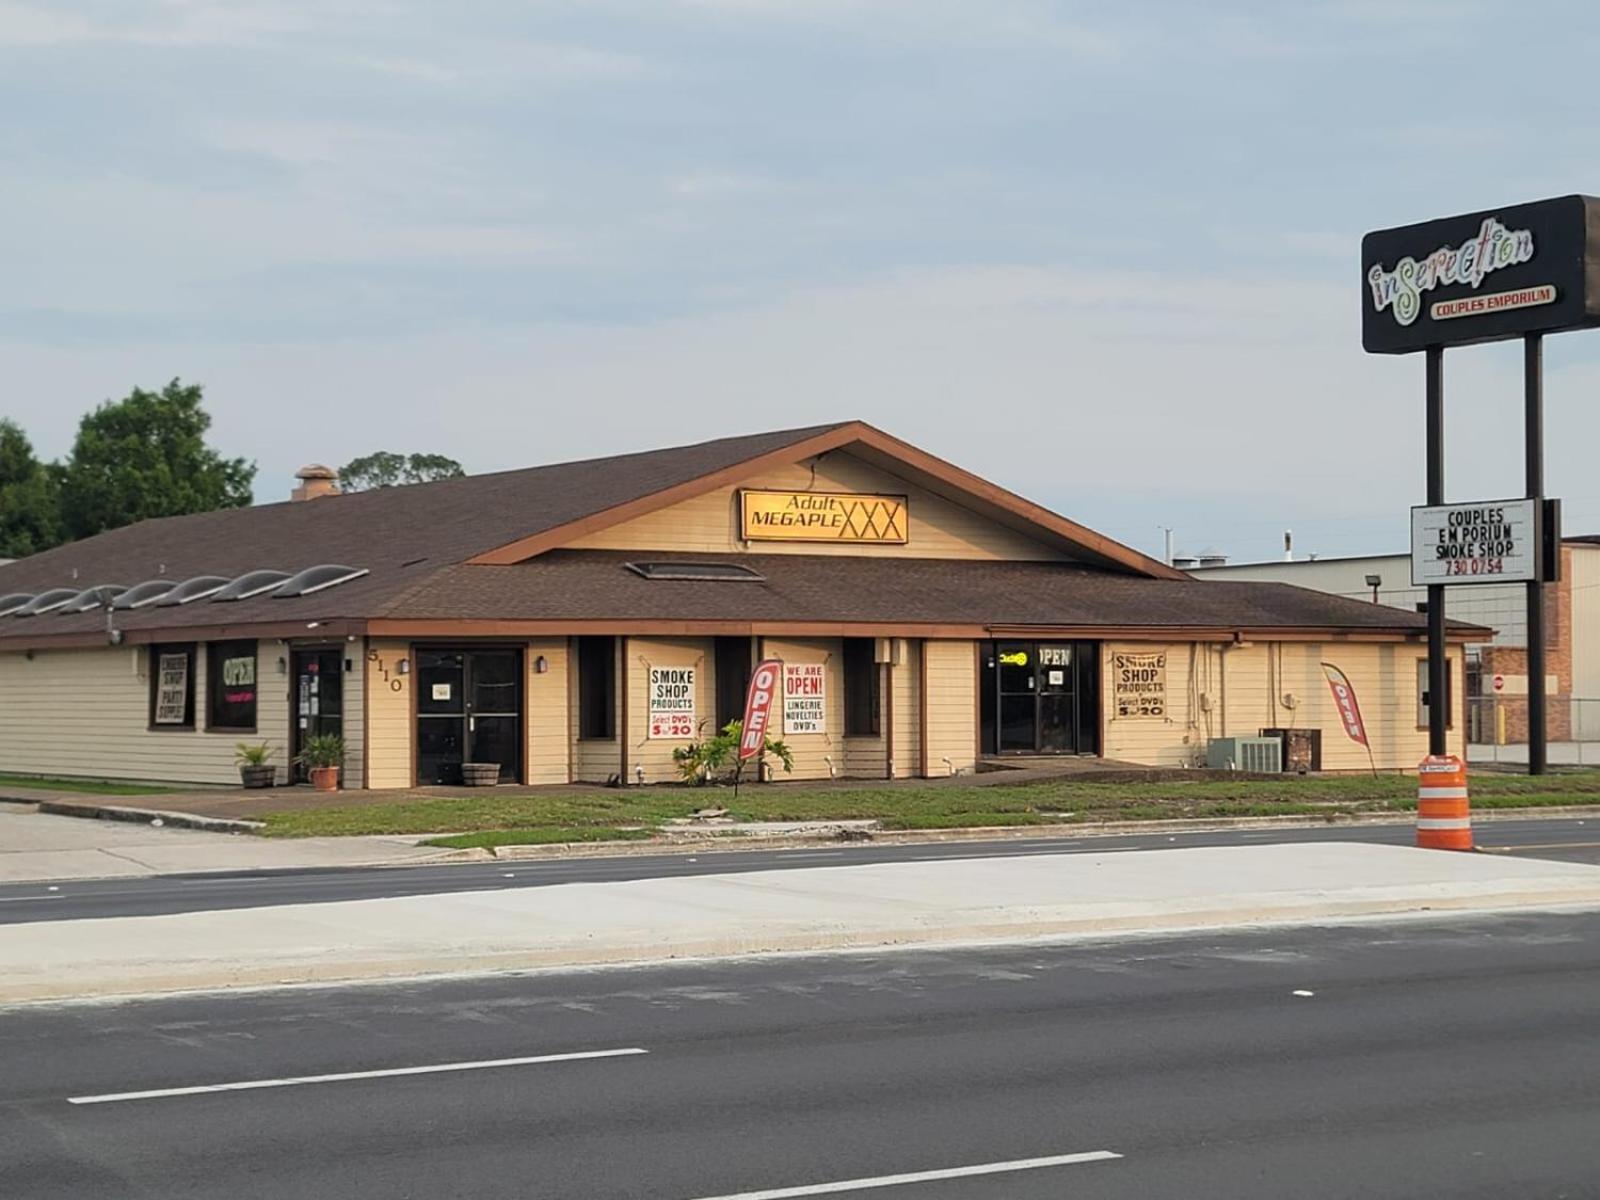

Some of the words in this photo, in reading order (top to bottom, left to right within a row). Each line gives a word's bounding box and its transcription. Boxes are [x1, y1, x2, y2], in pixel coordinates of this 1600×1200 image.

[1436, 298, 1485, 317] COUPLES
[1487, 289, 1551, 309] EMPORIUM
[786, 495, 836, 511] Adult
[1448, 508, 1504, 526] COUPLES
[1436, 543, 1474, 560] SMOKE
[1479, 540, 1514, 557] SHOP
[1446, 560, 1467, 576] 730
[1471, 558, 1503, 574] 0754
[368, 649, 402, 692] 5110
[651, 670, 694, 684] SMOKE
[787, 667, 802, 676] WE
[804, 666, 823, 676] ARE
[1122, 669, 1158, 682] SHOP
[657, 685, 689, 698] SHOP
[787, 677, 823, 695] OPEN!
[1117, 683, 1164, 693] PRODUCTS
[651, 699, 693, 710] PRODUCTS
[743, 671, 774, 749] OPEN
[787, 701, 822, 710] LINGERIE
[1119, 706, 1128, 716] 5
[785, 711, 824, 720] NOVELTIES
